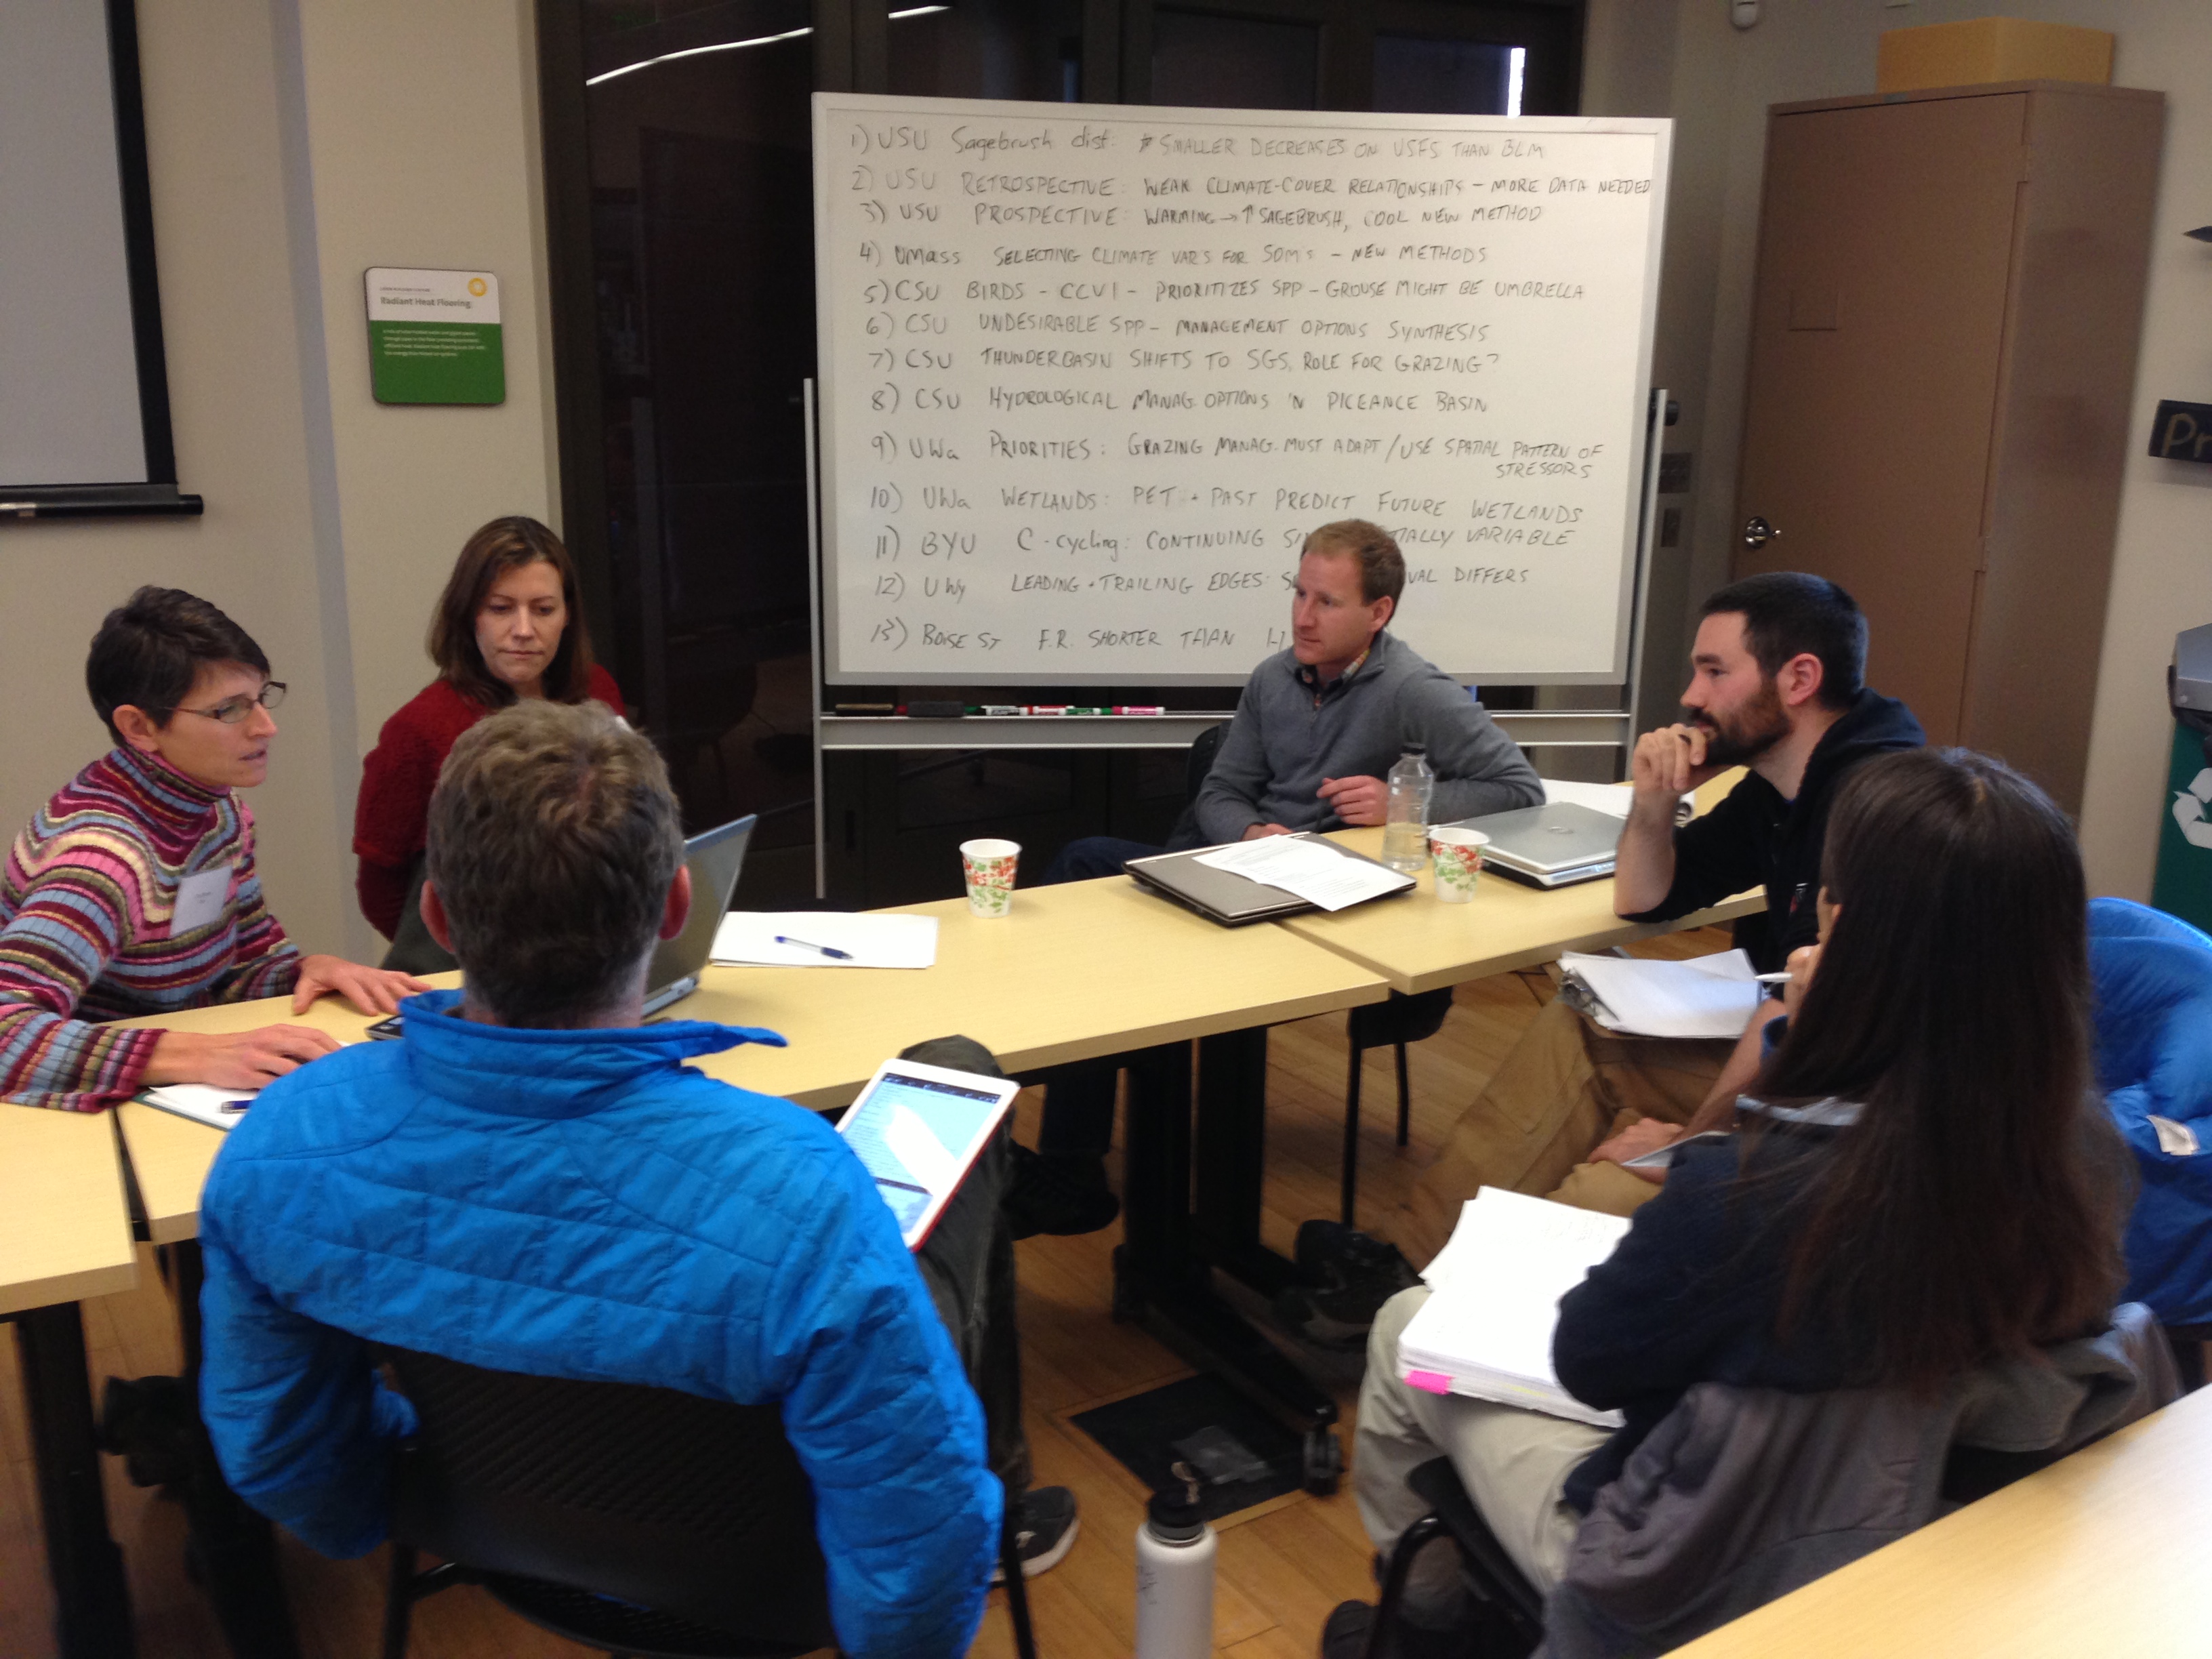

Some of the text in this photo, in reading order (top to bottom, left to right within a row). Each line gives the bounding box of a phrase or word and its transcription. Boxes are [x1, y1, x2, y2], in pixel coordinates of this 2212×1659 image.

[878, 125, 928, 151] USU
[951, 125, 1052, 162] Sagebrush
[1160, 134, 1235, 156] SMALLER
[1250, 137, 1347, 157] DECREASES
[1354, 142, 1378, 159] ON
[1393, 137, 1439, 159] USFS
[1452, 141, 1490, 157] THAN
[1501, 138, 1544, 159] BLM
[851, 164, 872, 191] 2)
[886, 167, 935, 190] USU
[1143, 177, 1191, 197] WEAK
[1348, 178, 1465, 200] RELATIONSHIPS
[1490, 178, 1540, 194] MORE
[1548, 176, 1589, 194] DATA
[1597, 178, 1651, 195] NEEDED
[859, 199, 888, 224] 3)
[899, 203, 939, 223] USU
[1143, 207, 1216, 226] WARMING
[1363, 210, 1410, 228] COOL
[1421, 207, 1460, 224] NEW
[1471, 204, 1542, 222] METHOD
[859, 240, 882, 268] 4)
[993, 245, 1082, 267] SELECTING
[1091, 246, 1158, 266] CLIMATE
[1222, 249, 1249, 265] FOR
[1351, 243, 1387, 262] NEW
[1398, 244, 1487, 264] METHODS
[380, 297, 413, 305] Radiant
[437, 299, 472, 309] Flooring
[863, 278, 891, 304] 5)
[894, 279, 940, 302] CSU
[966, 280, 1025, 301] BIRDS
[1155, 279, 1261, 303] PRIORITIZES
[1271, 279, 1304, 298] SPP
[1325, 279, 1388, 298] GROUSE
[1395, 279, 1449, 297] MIGHT
[1458, 279, 1485, 295] BE
[1494, 281, 1585, 300] UMBRELLA
[865, 311, 895, 340] 6)
[905, 313, 947, 335] CSU
[979, 311, 1101, 333] UNDESIRABLE
[1175, 318, 1290, 337] MANAGEMENT
[1300, 319, 1368, 338] OPTIONS
[1387, 320, 1491, 343] SYNTHESIS
[868, 348, 896, 373] 7)
[905, 348, 953, 370] CSU
[1129, 348, 1193, 370] SHIFTS
[1204, 350, 1231, 371] TO
[1303, 350, 1340, 371] ROLE
[1351, 352, 1383, 372] FOR
[1394, 352, 1500, 374] GRAZING?
[871, 382, 901, 415] 8)
[914, 387, 961, 411] CSU
[989, 386, 1119, 412] HYDROLOGICAL
[1204, 389, 1269, 410] OPTIONS
[1326, 390, 1419, 411] PICEANCE
[1435, 390, 1488, 413] BASIN
[871, 430, 898, 460] 9)
[1128, 432, 1204, 457] GRAZING
[1283, 437, 1324, 453] MUST
[1443, 437, 1500, 457] SPATIAL
[1512, 441, 1571, 459] PATTERN
[1578, 443, 1605, 459] OF
[1495, 461, 1593, 479] STRESSORS
[870, 481, 903, 514] 10)
[1133, 485, 1177, 507] PET
[1211, 486, 1258, 508] PAST
[1275, 487, 1357, 511] PREDICT
[1377, 490, 1447, 517] FUTURE
[1471, 499, 1584, 524] WETLANDS
[876, 524, 901, 562] 11)
[920, 531, 977, 561] BYU
[1145, 528, 1265, 551] CONTINUING
[1466, 525, 1576, 547] VARIABLE
[874, 571, 905, 603] 12)
[1010, 573, 1080, 593] LEADING
[1098, 573, 1194, 595] TRAILING
[1454, 566, 1530, 584] DIFFERS
[1087, 628, 1162, 649] SHORTER
[1179, 627, 1235, 649] THAN
